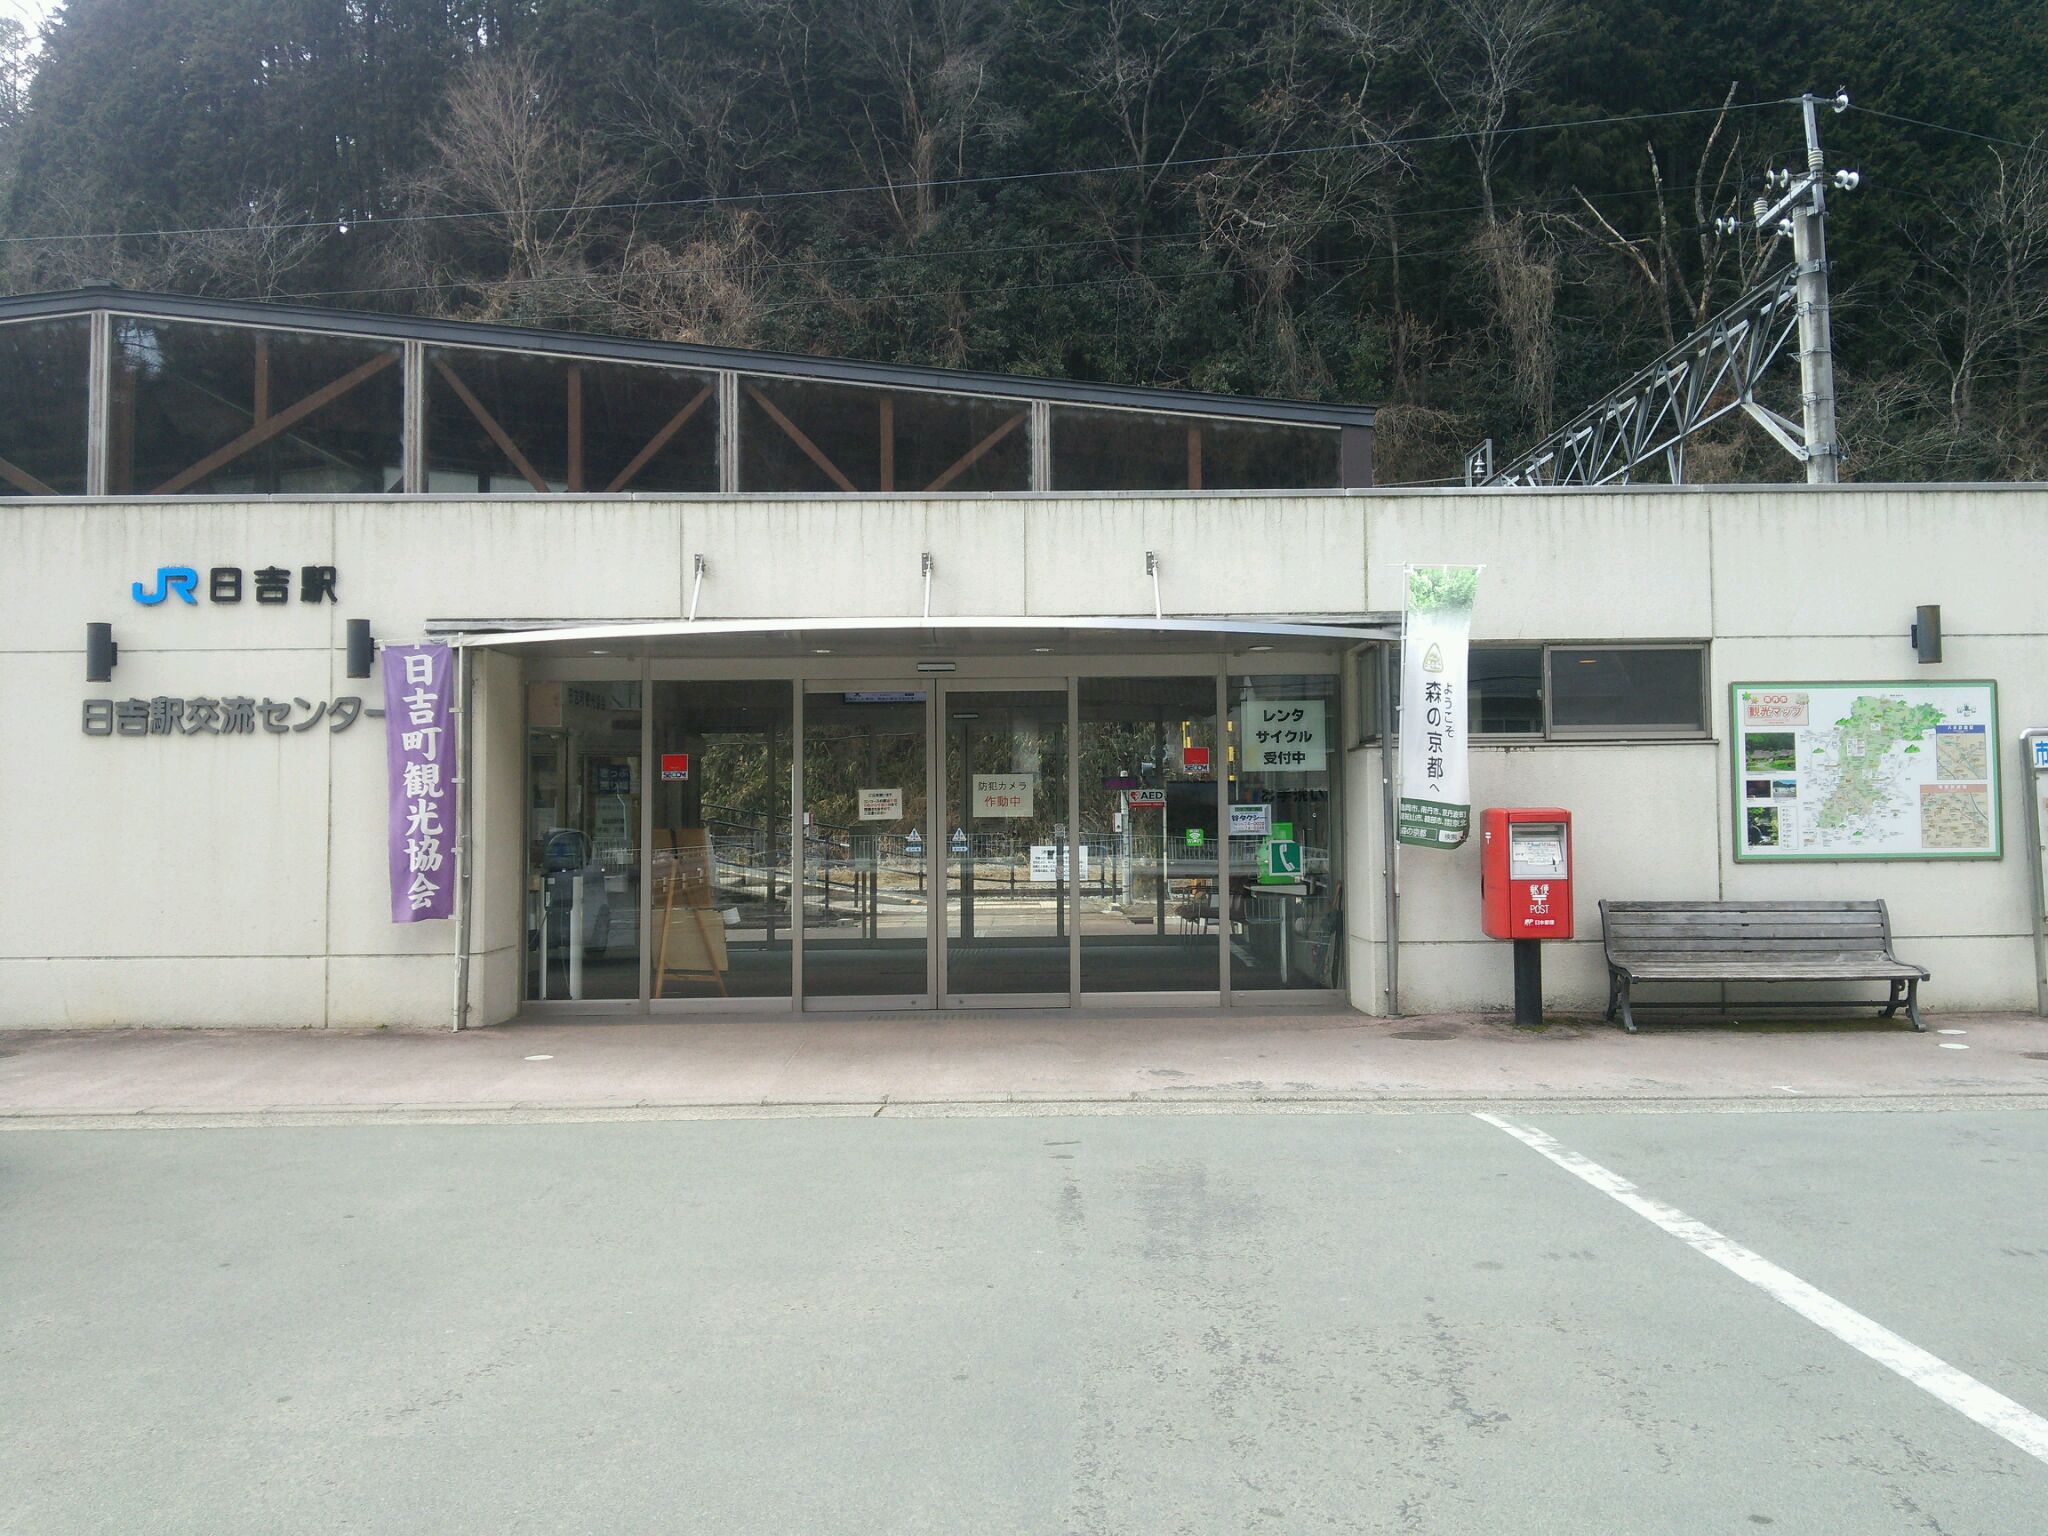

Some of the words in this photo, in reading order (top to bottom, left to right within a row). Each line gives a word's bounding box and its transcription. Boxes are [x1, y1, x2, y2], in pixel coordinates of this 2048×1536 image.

[132, 567, 199, 606] JR
[209, 565, 338, 604] 日吉駅
[81, 696, 386, 737] 日吉駅交流センター
[1263, 708, 1304, 723] レンタ
[1443, 682, 1454, 739] ようこそ
[1256, 730, 1313, 744] サイクル
[1425, 680, 1444, 793] 森の京都へ
[1263, 751, 1306, 766] 受付中
[401, 653, 444, 911] 日吉町観光協会
[978, 781, 1027, 792] 防犯カメラ
[984, 795, 1021, 808] 作動中
[1140, 791, 1163, 800] AED
[1530, 904, 1550, 914] POST
